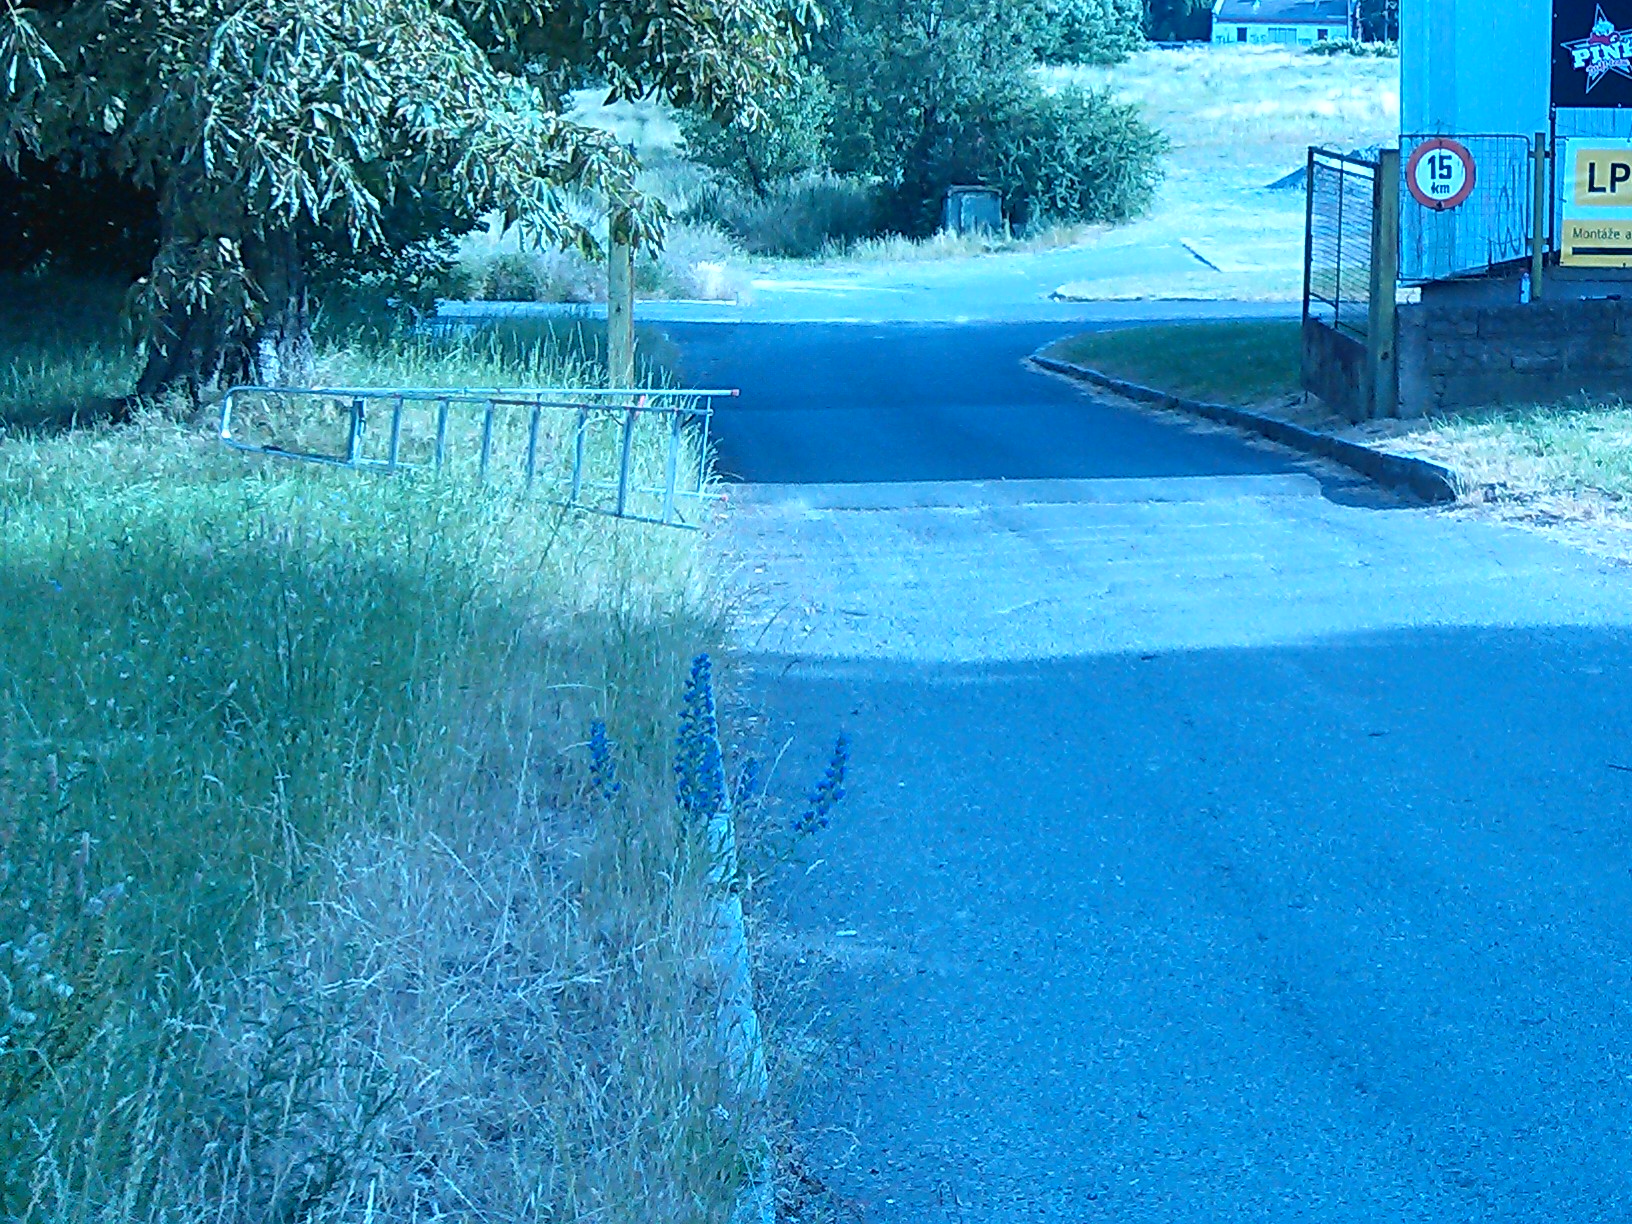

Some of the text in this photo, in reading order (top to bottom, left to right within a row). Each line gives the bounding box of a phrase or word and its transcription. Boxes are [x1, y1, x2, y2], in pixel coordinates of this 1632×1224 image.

[1427, 155, 1452, 180] 15
[1431, 182, 1450, 195] km
[1572, 226, 1620, 241] Montáže
[1625, 231, 1632, 240] a
